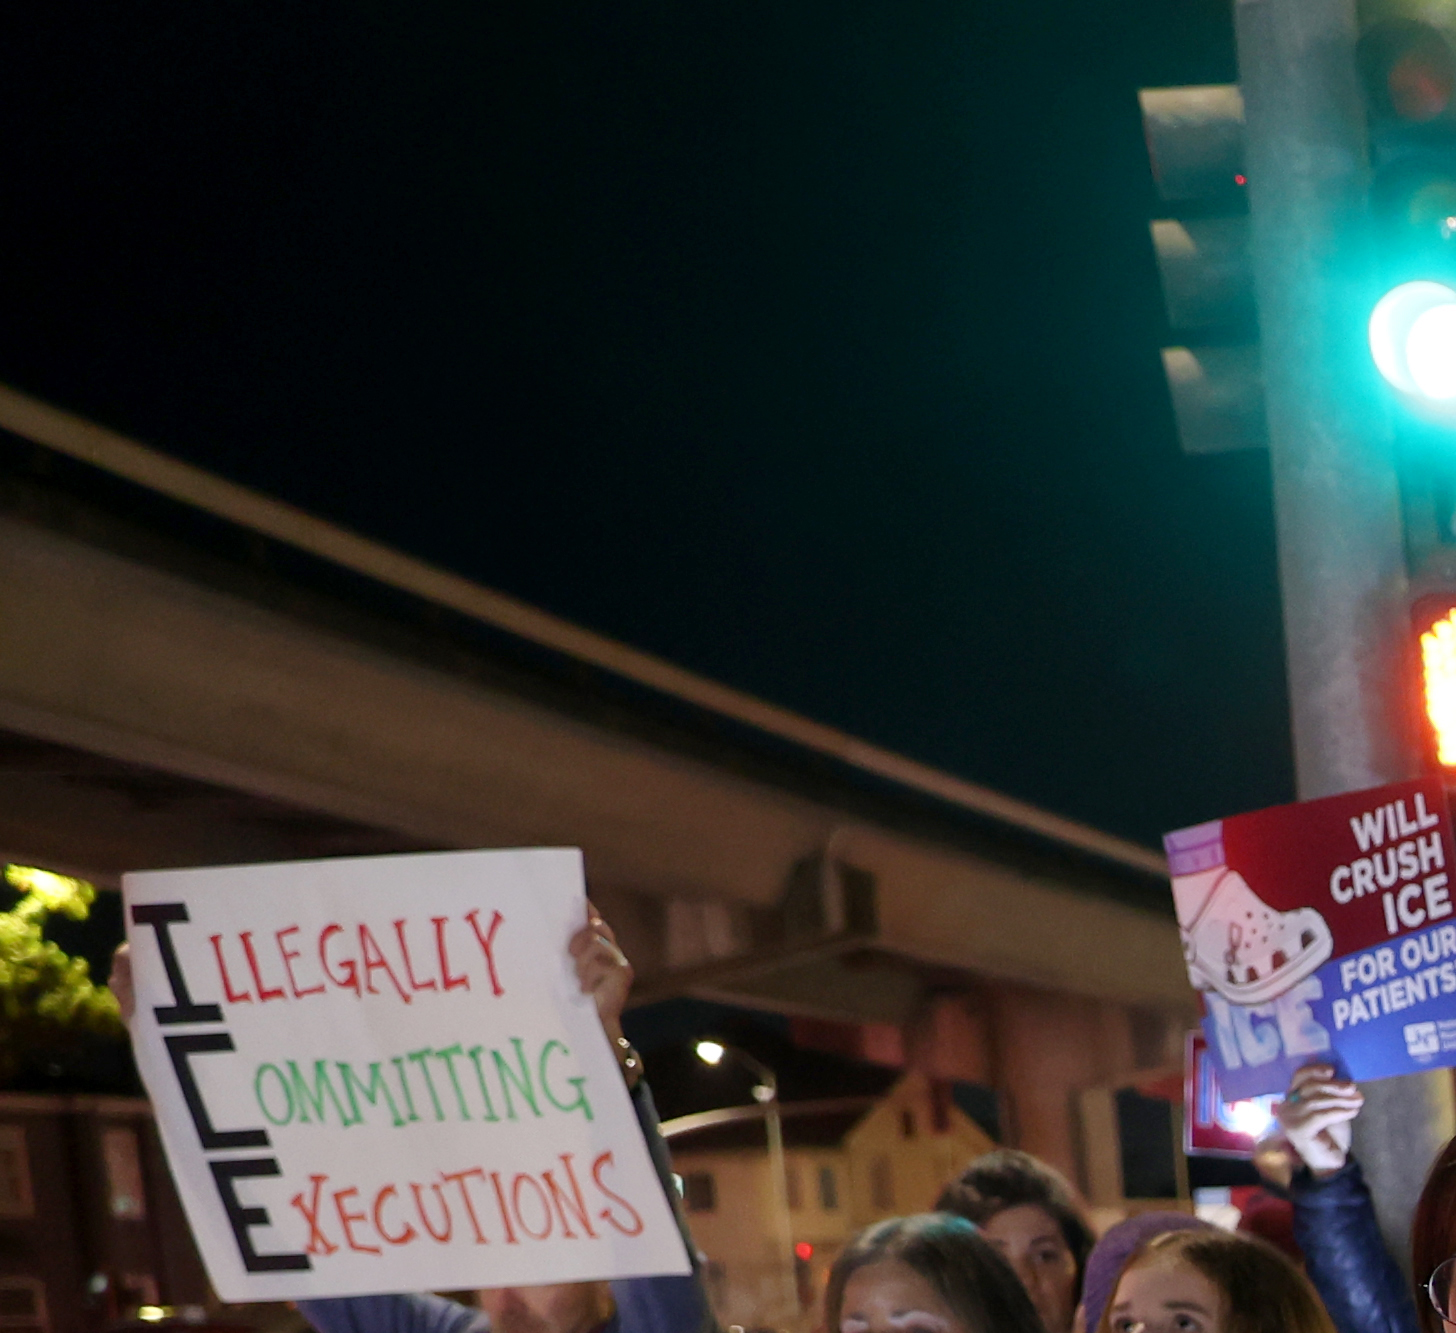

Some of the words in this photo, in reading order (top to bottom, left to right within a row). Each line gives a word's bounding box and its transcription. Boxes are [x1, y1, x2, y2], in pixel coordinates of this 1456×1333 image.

[1350, 792, 1440, 853] WILL
[1330, 831, 1445, 906] CRUSH
[1383, 873, 1453, 936] ICE
[131, 901, 506, 1025] ILLEGALLY
[1341, 946, 1397, 993] FOR
[162, 1032, 596, 1149] COMMITTING
[209, 1150, 645, 1273] EXECUTIONS
